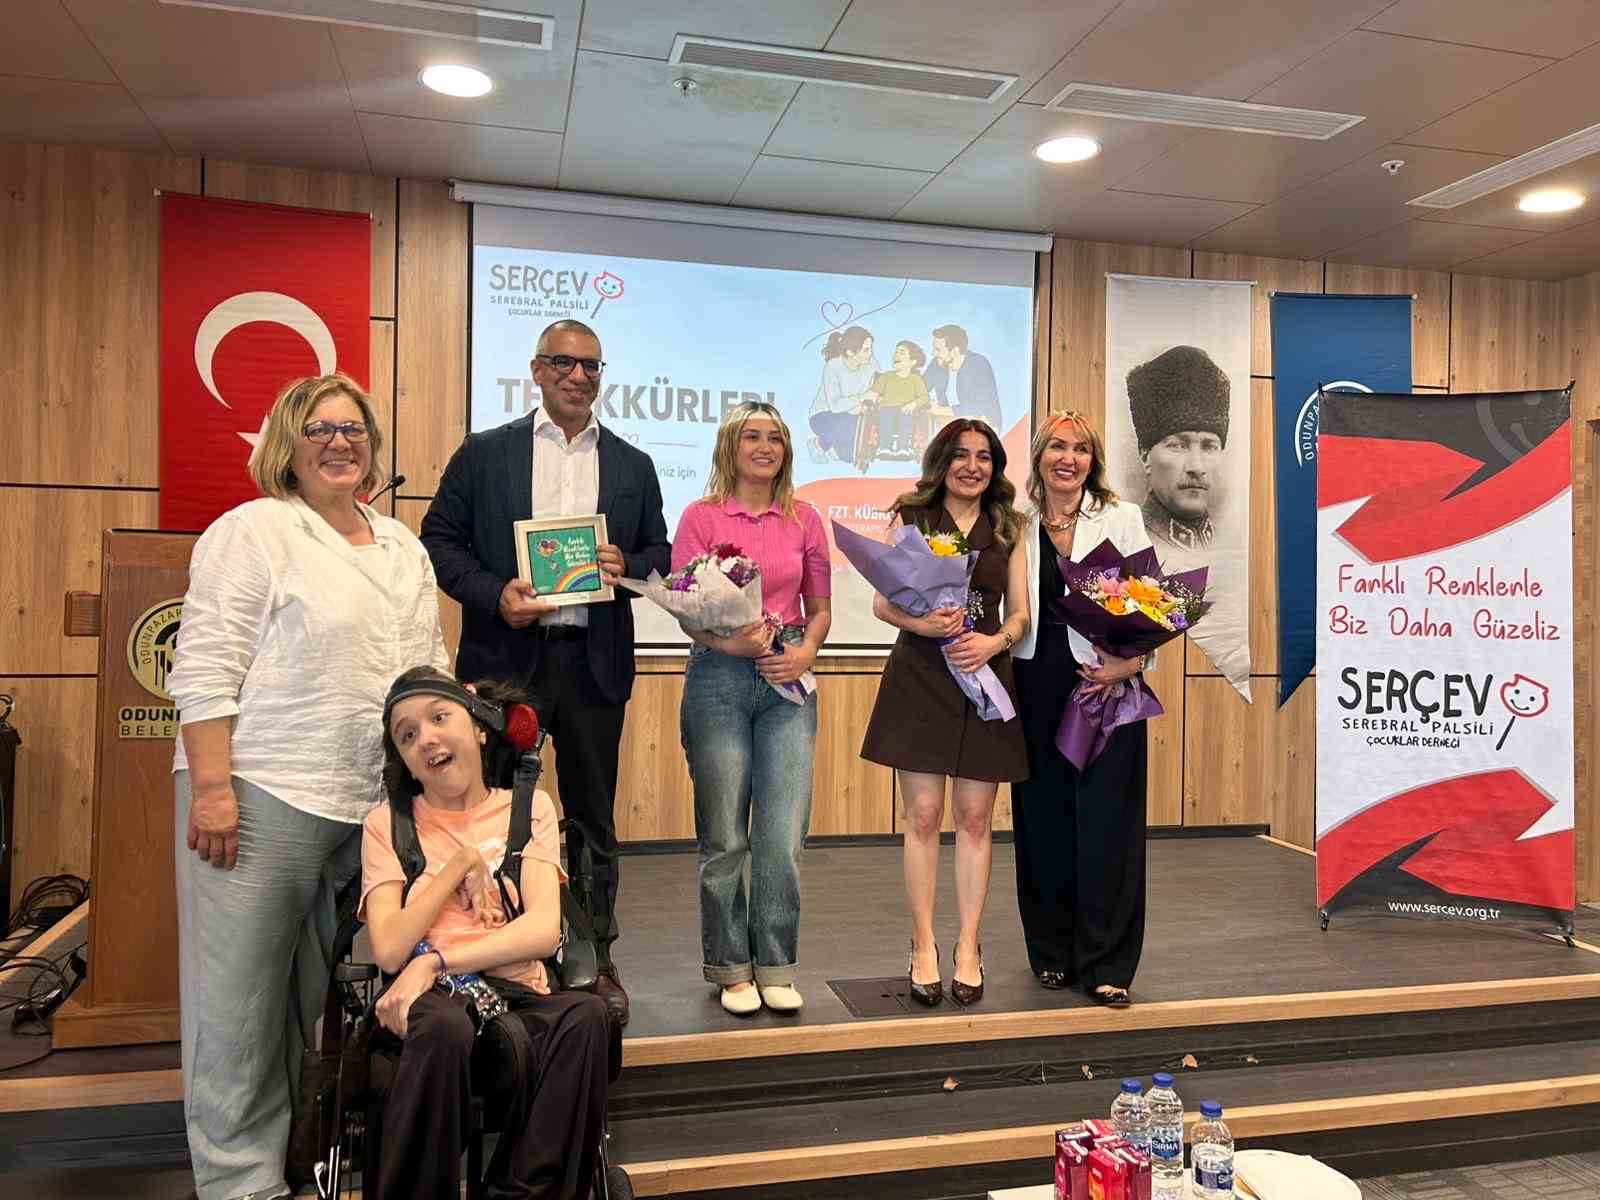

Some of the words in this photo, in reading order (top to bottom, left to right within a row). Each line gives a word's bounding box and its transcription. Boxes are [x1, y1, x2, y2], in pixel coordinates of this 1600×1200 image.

[489, 264, 588, 299] SERÇEV
[490, 295, 543, 307] SEREBRAL
[1303, 405, 1319, 460] ODUNPA
[1338, 564, 1405, 594] Farklı
[1426, 566, 1543, 597] Renklerle
[1329, 605, 1368, 634] Biz
[1388, 607, 1452, 637] Daha
[1473, 609, 1560, 640] Güzeliz
[1337, 667, 1493, 724] SERÇEV
[121, 708, 180, 721] ODUN
[121, 725, 173, 736] BELE
[1342, 717, 1418, 732] SEREBRAL
[1432, 721, 1494, 735] PALSİLİ
[1366, 735, 1420, 747] ÇOCUKLAR
[1387, 901, 1501, 920] www.sercev.org.tr
